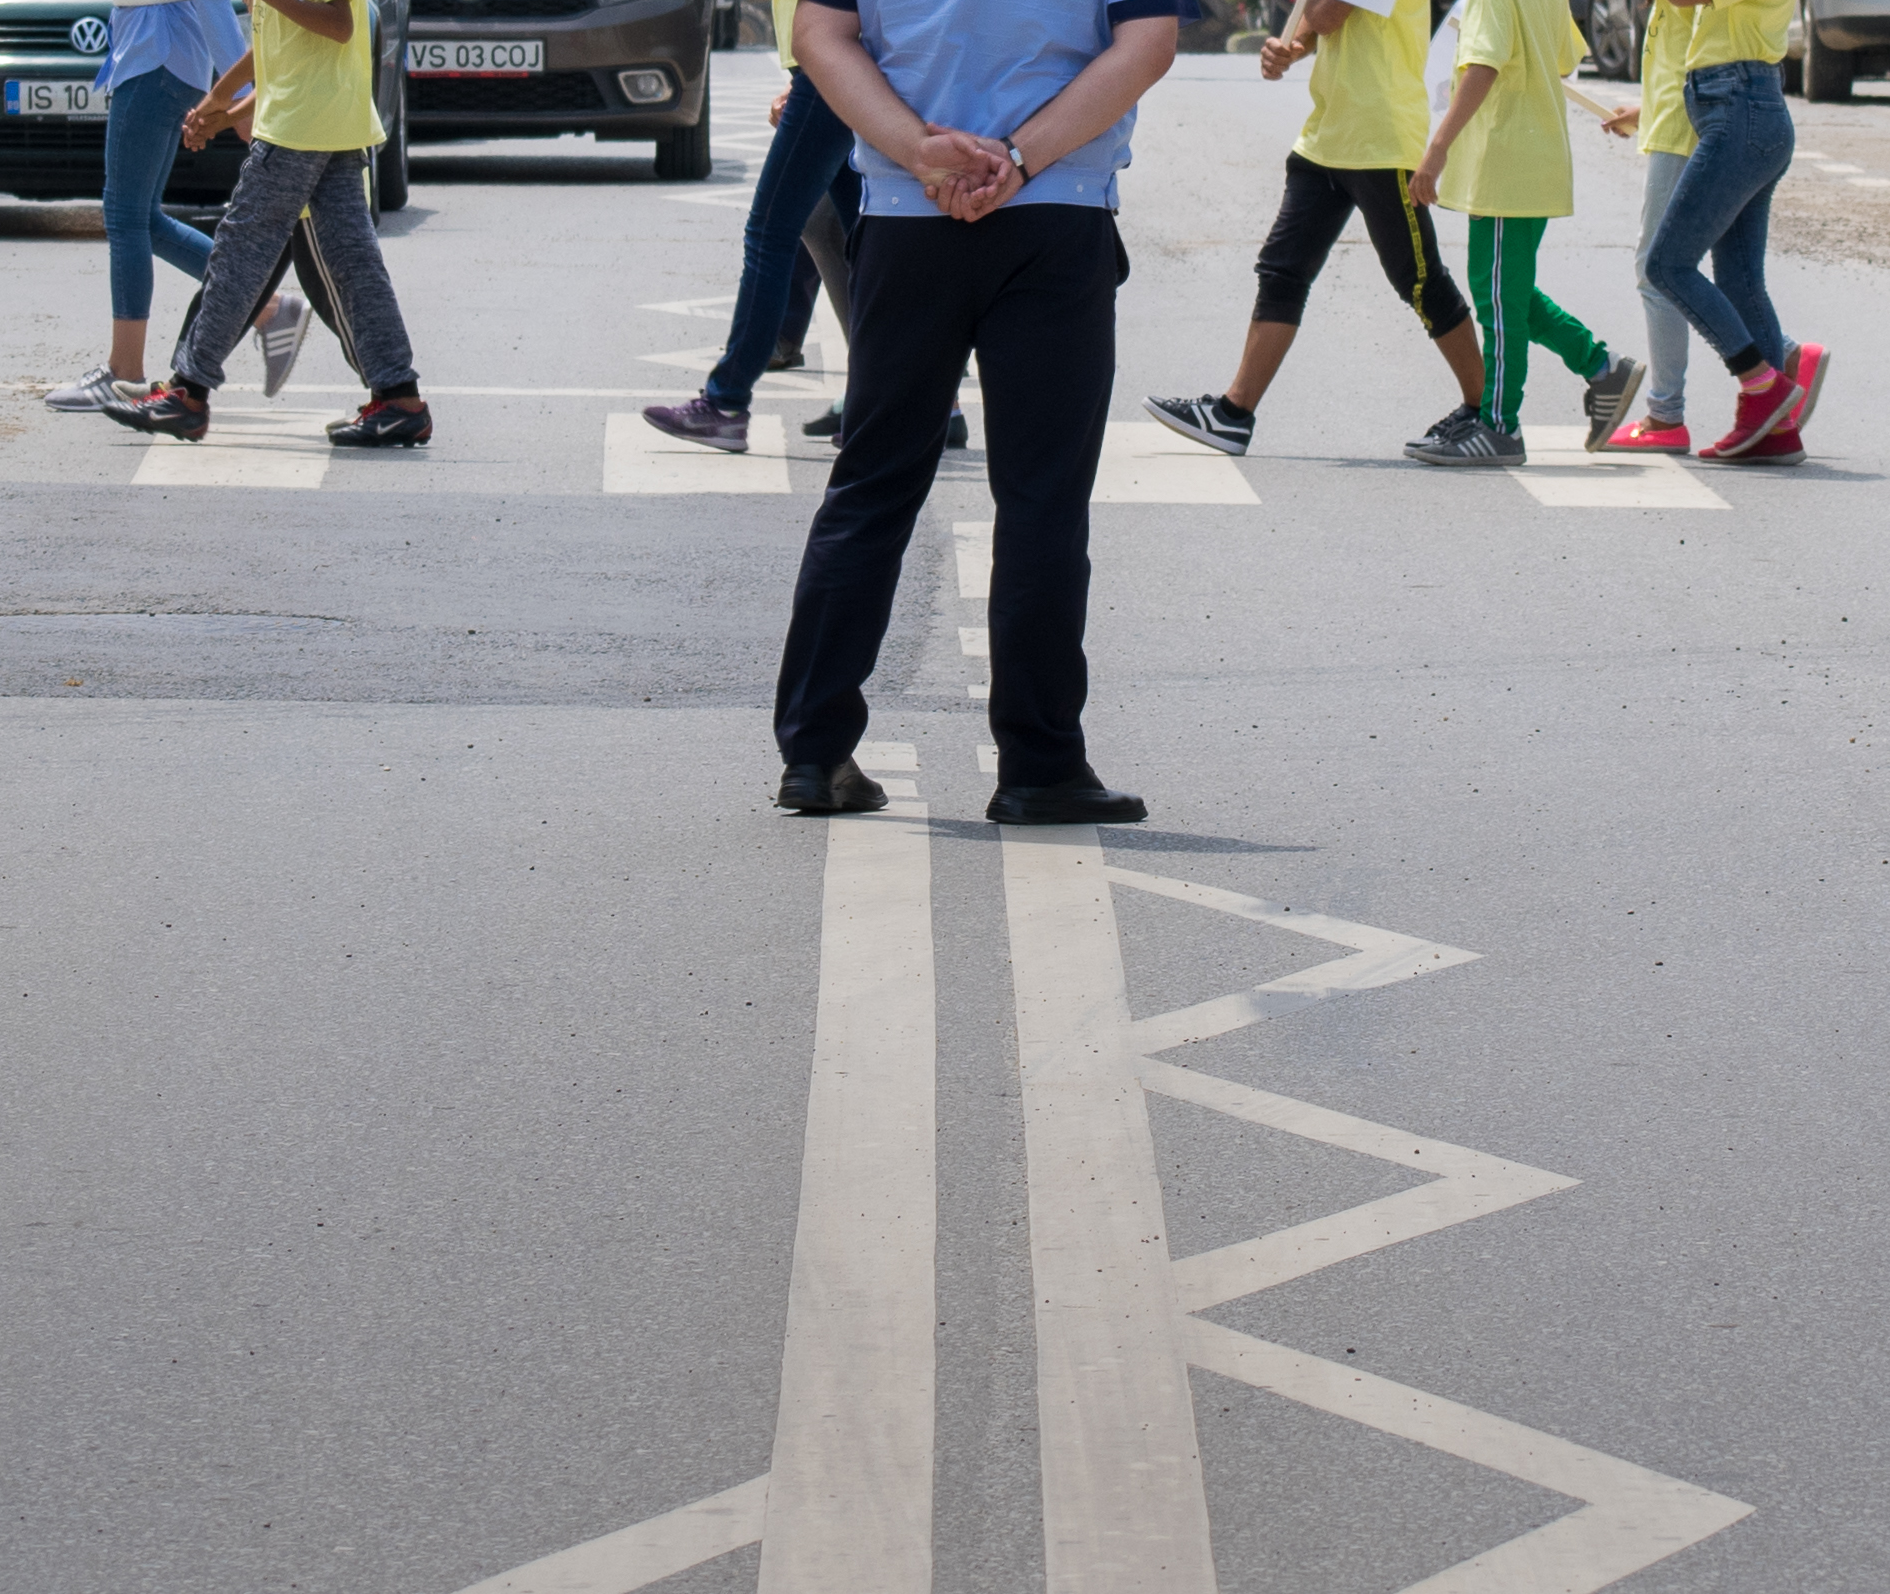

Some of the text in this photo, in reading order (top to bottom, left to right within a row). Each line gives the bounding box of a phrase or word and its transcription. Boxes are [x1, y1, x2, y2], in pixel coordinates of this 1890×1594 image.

[412, 44, 539, 68] VS 03 COJ
[28, 85, 52, 110] IS
[64, 85, 89, 110] 10
